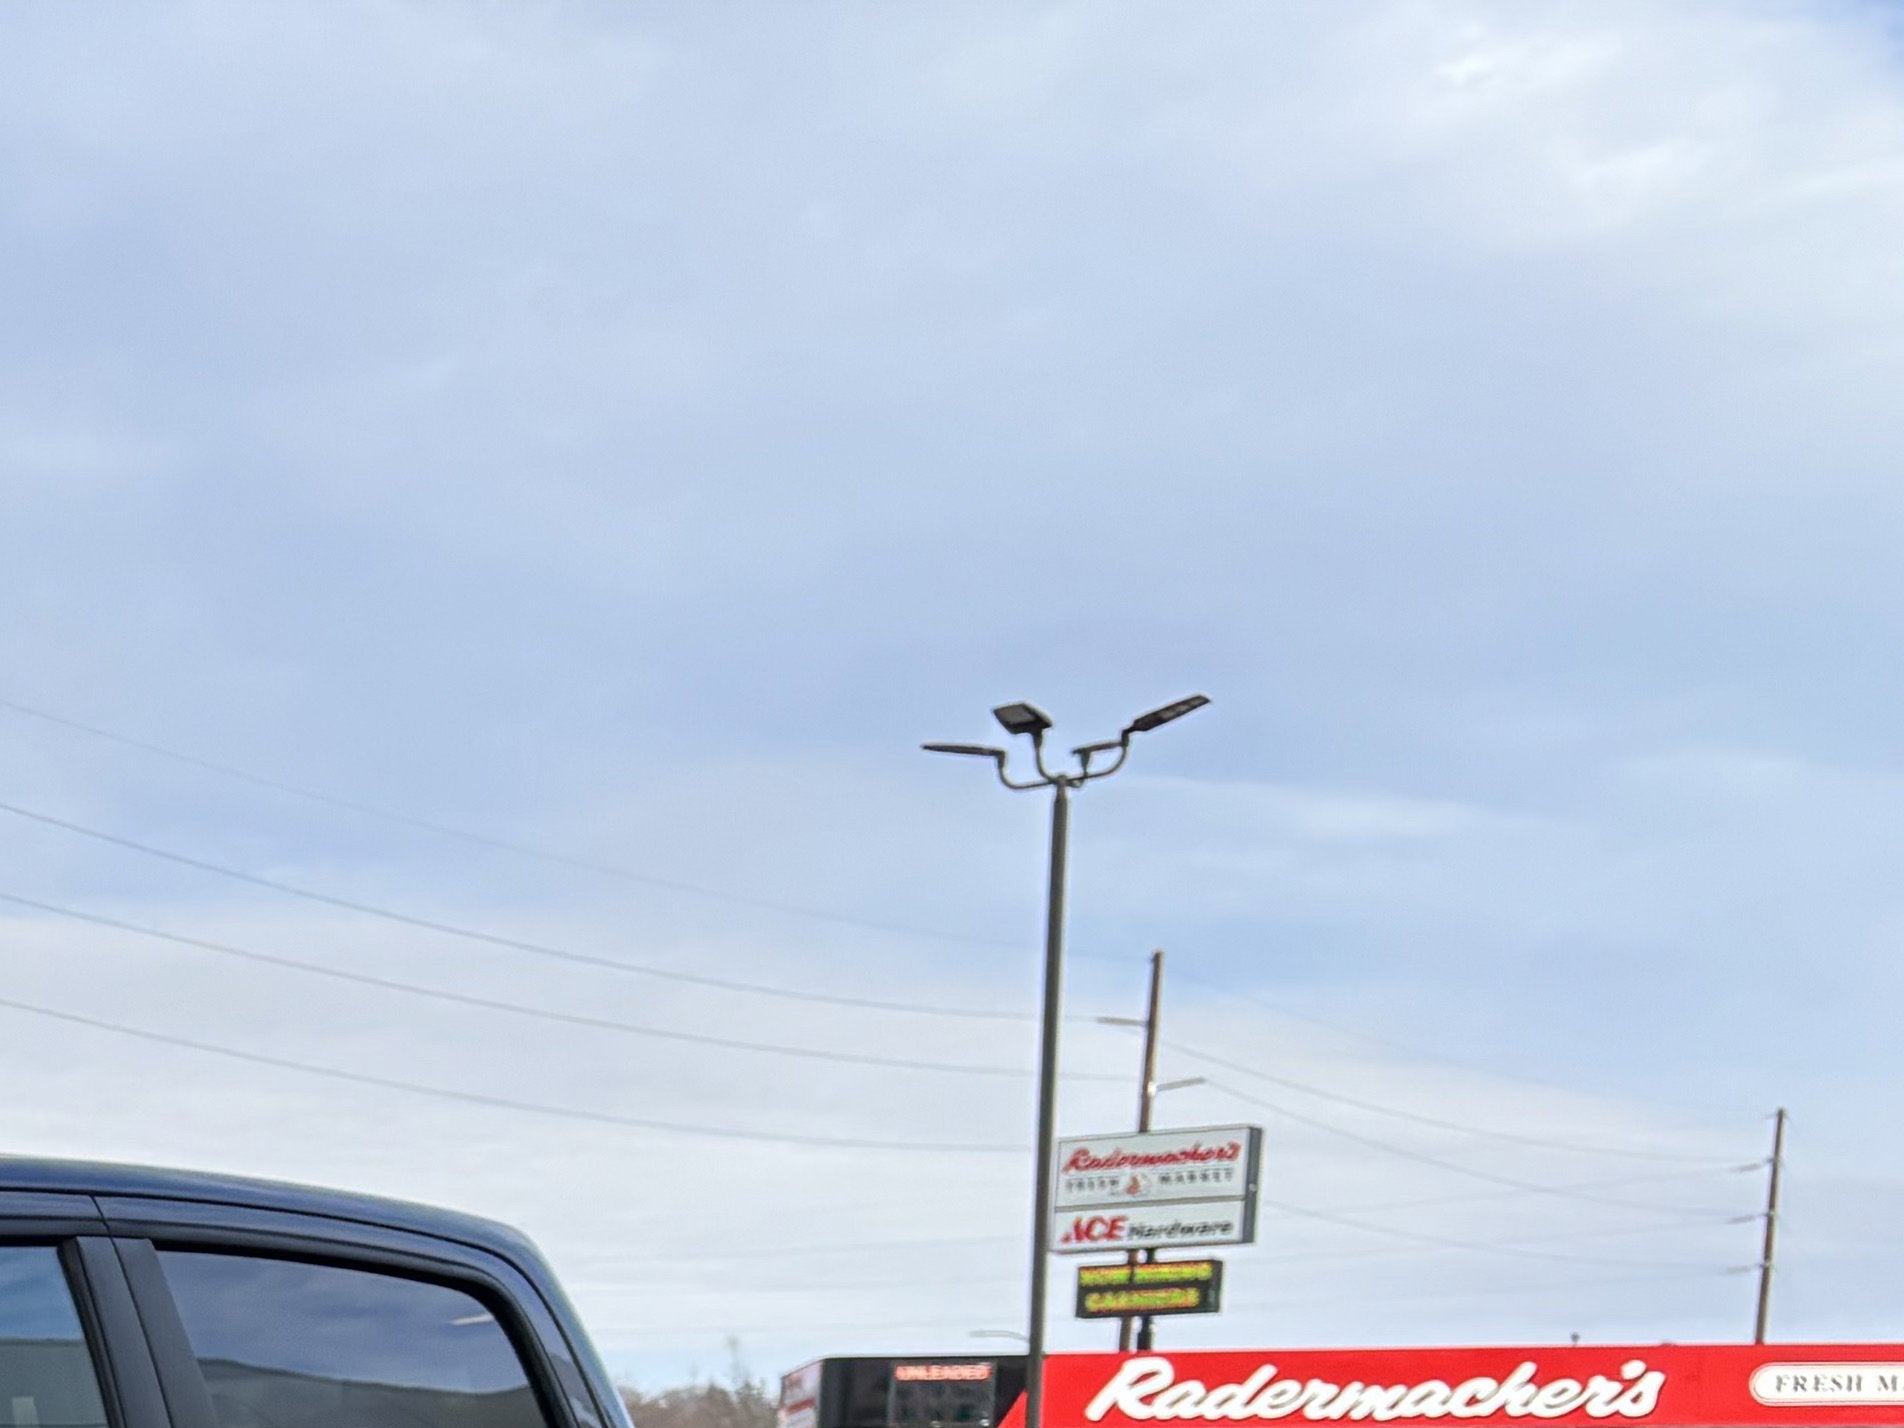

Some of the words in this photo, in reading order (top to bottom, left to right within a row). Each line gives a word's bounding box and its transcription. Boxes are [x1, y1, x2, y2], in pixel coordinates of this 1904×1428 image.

[1060, 1215, 1129, 1245] ACE
[1128, 1218, 1233, 1240] Hardware
[1084, 1357, 1667, 1421] Radermacher's
[1776, 1374, 1863, 1392] FRESH
[1877, 1374, 1904, 1392] M
